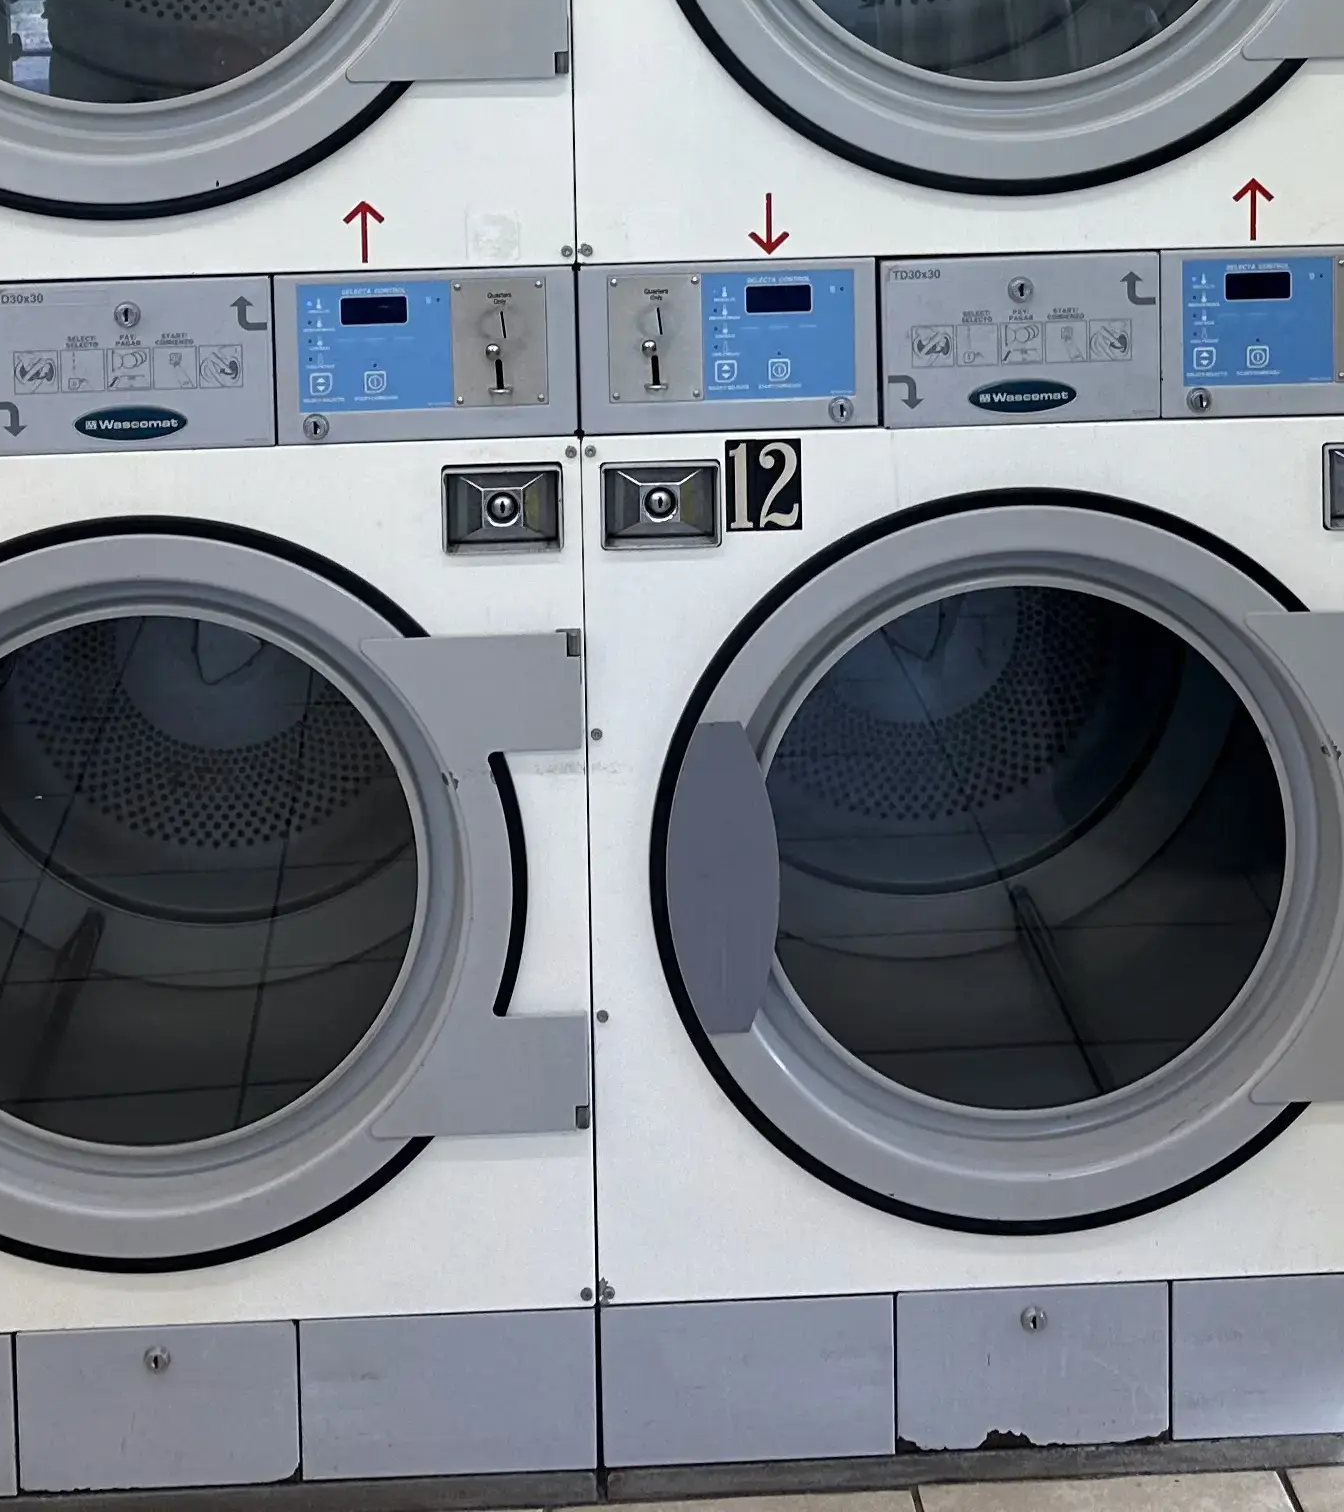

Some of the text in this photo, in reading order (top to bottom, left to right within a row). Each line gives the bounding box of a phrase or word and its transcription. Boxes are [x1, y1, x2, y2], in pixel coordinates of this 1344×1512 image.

[893, 269, 941, 280] TD30x30
[992, 390, 1069, 403] Wascomat
[99, 417, 179, 430] Wascomat
[728, 440, 799, 529] 12
